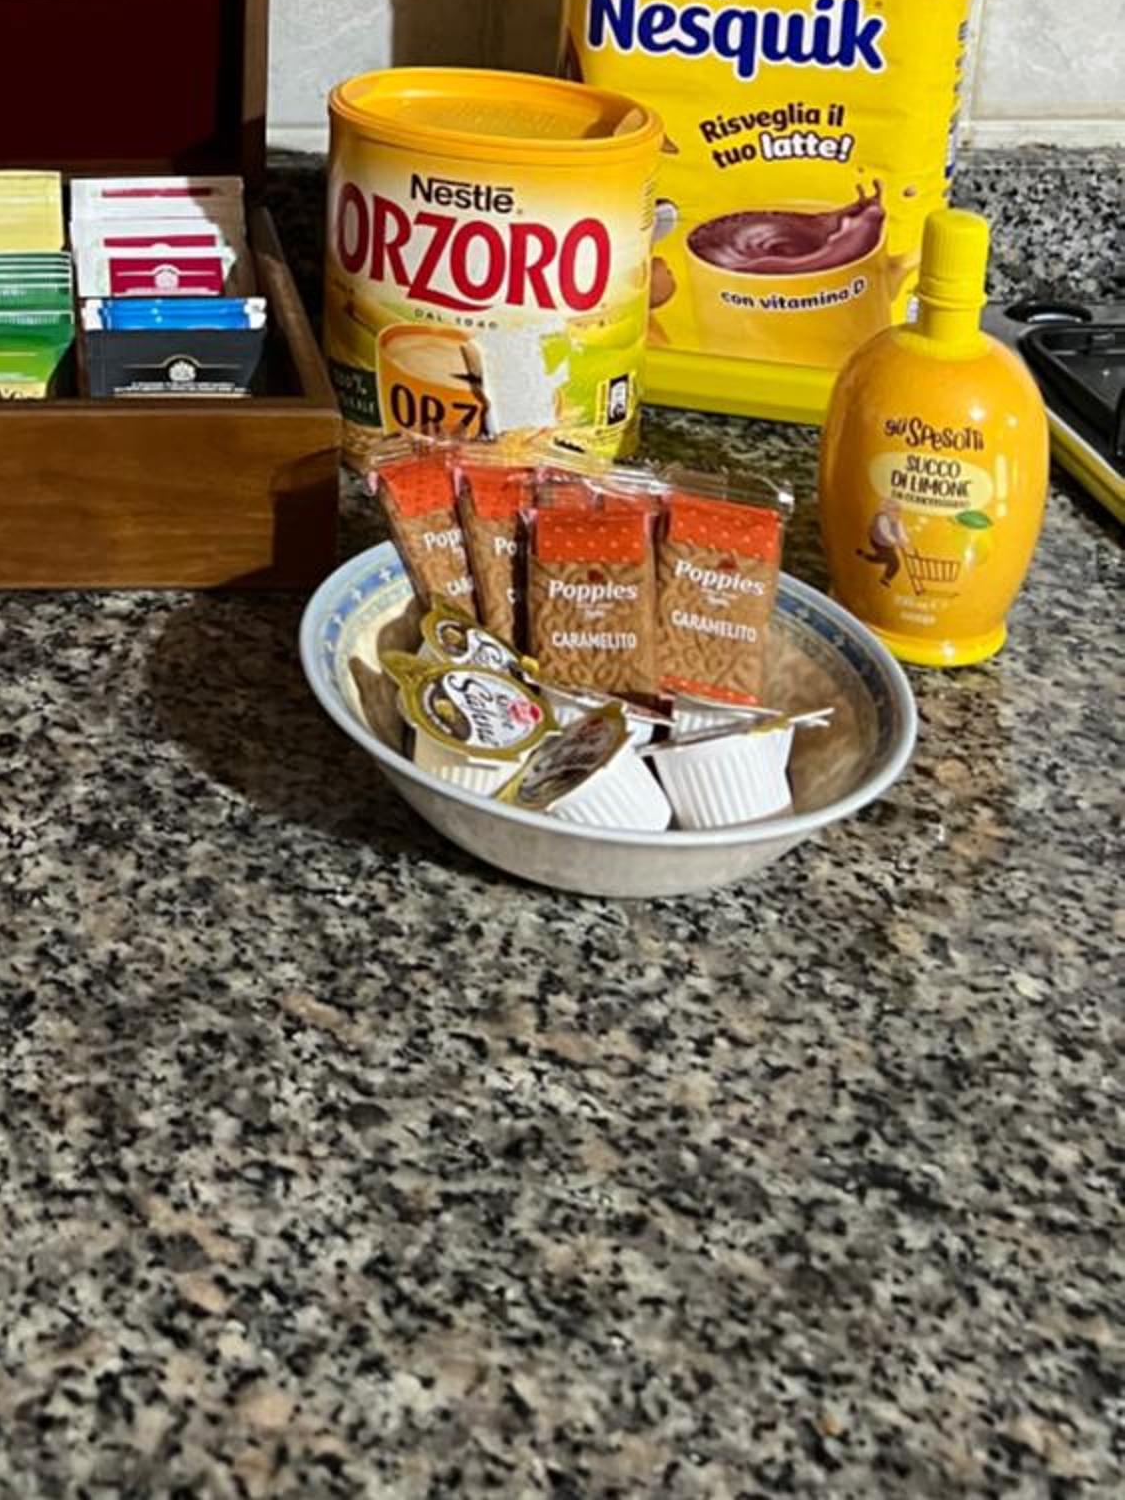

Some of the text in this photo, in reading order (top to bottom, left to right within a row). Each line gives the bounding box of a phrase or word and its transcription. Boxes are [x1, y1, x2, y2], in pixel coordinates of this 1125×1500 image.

[699, 101, 845, 144] Risveglia il
[712, 131, 854, 169] tuo latte!
[336, 181, 612, 312] ORZORO
[720, 279, 865, 309] con vitamina D
[906, 454, 962, 478] SUCCO
[910, 475, 972, 497] LIMONE
[548, 578, 639, 604] Poppies
[674, 558, 765, 597] Poppies
[551, 631, 638, 650] CARAMELITO
[671, 609, 758, 643] CARAMELITO
